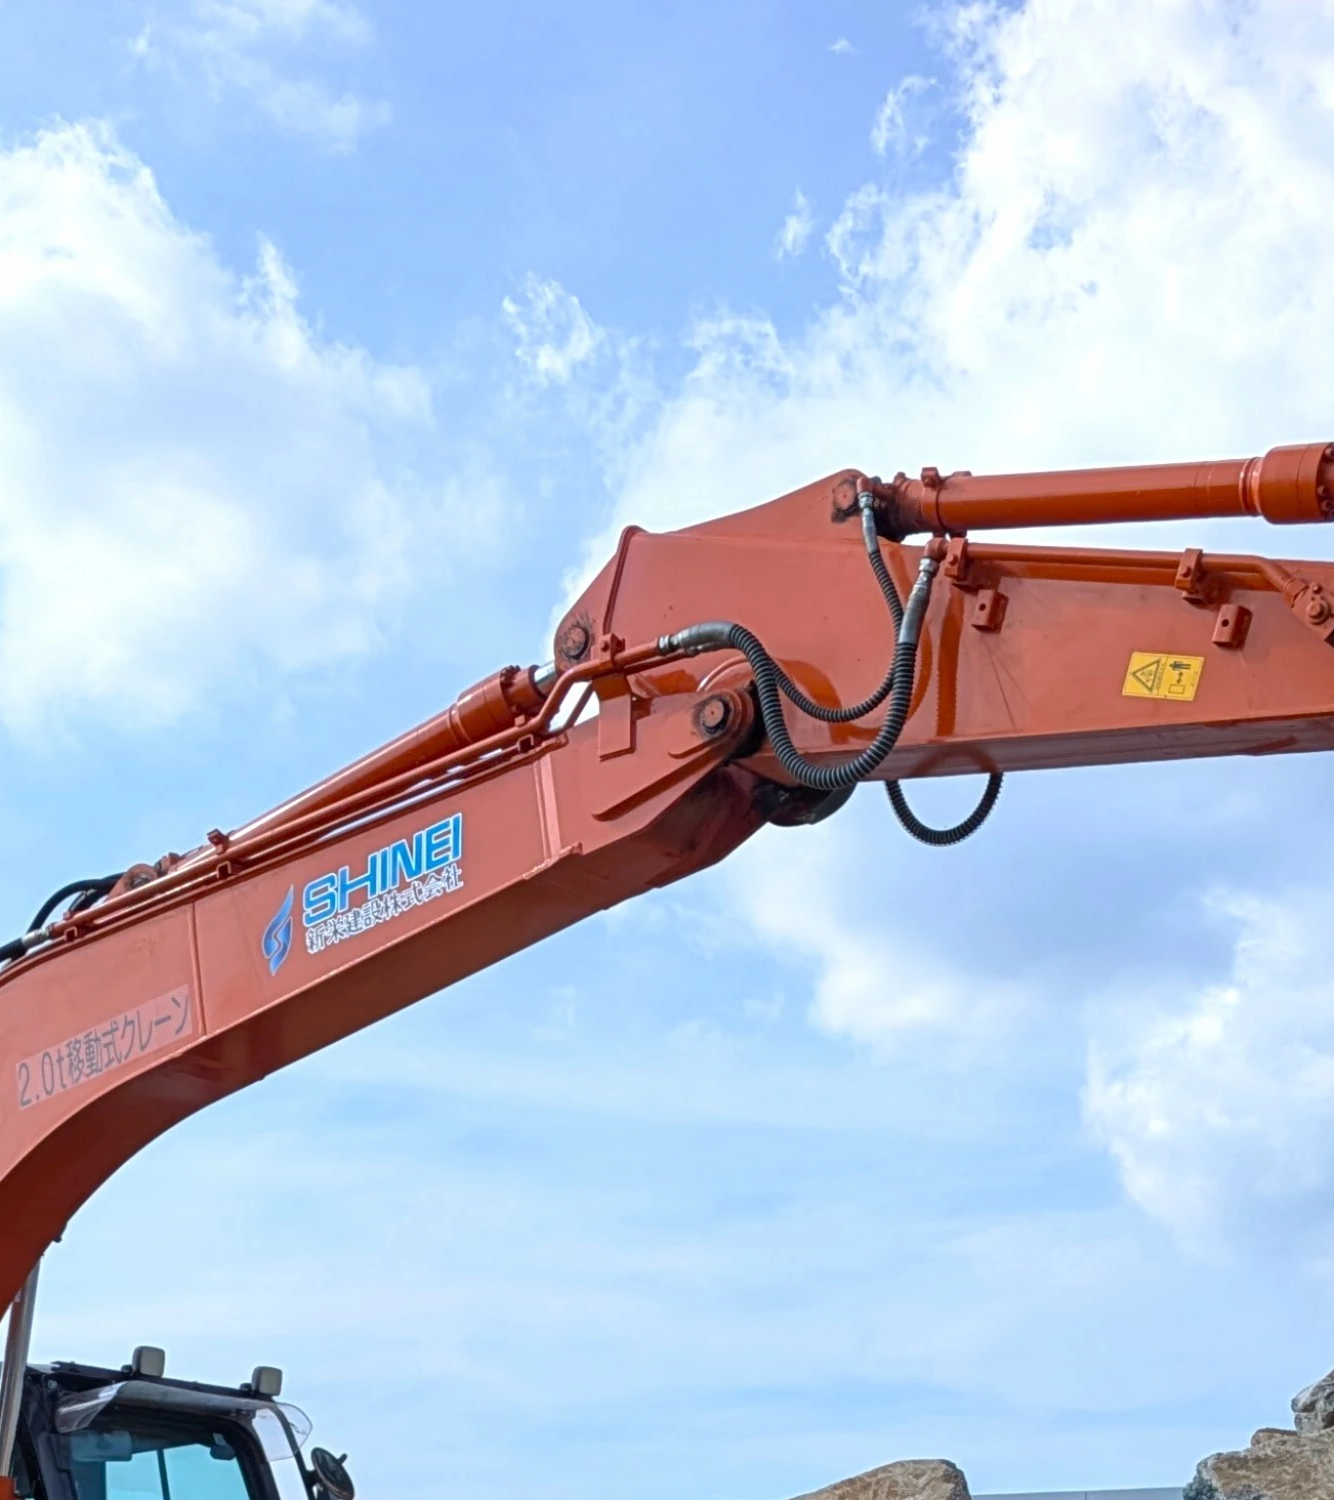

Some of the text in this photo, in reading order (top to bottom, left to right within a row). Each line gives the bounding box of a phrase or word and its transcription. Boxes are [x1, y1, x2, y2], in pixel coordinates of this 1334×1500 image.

[303, 812, 462, 927] SHINEI
[305, 863, 464, 954] 新栄建設株式会社
[18, 995, 190, 1107] 2.0t移動式クレーン
